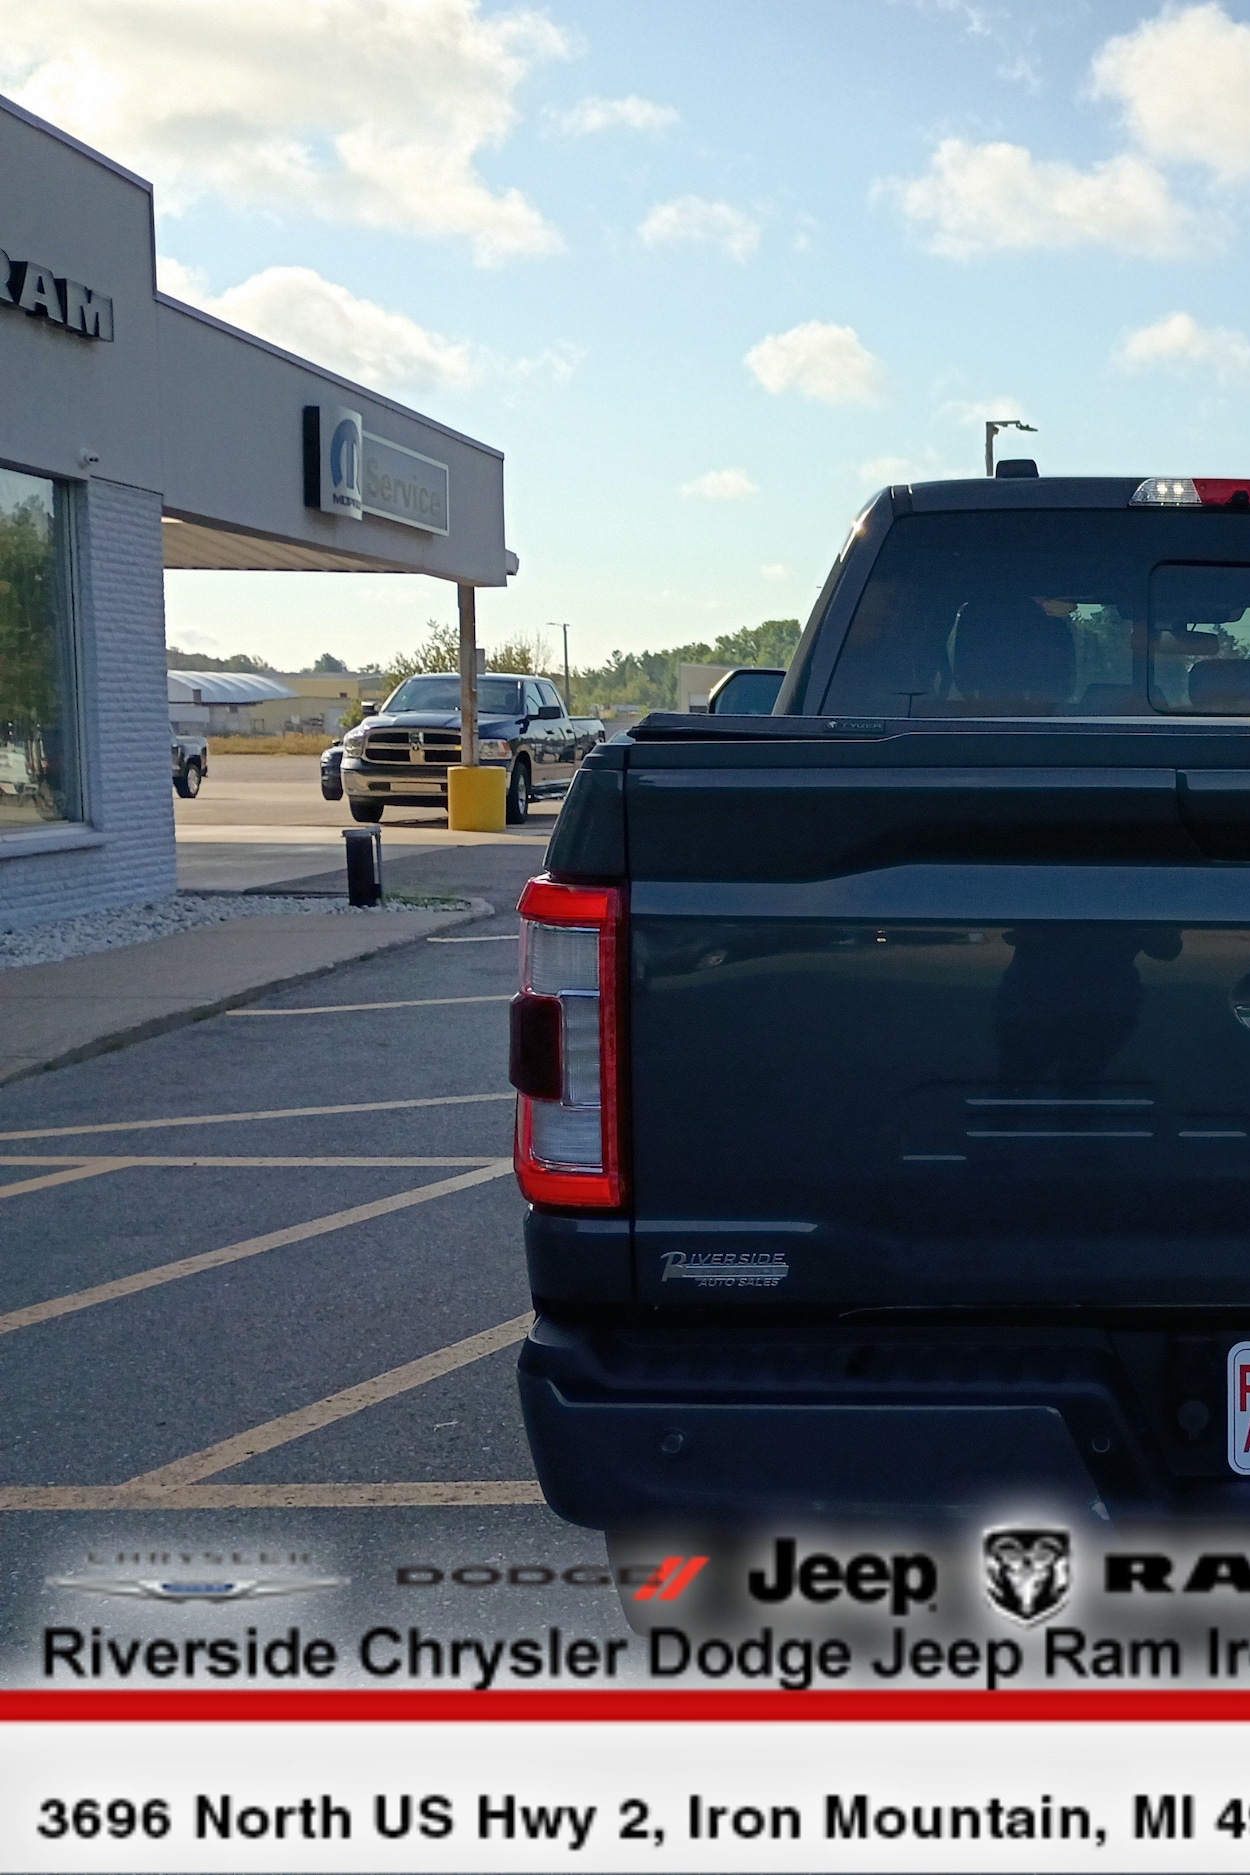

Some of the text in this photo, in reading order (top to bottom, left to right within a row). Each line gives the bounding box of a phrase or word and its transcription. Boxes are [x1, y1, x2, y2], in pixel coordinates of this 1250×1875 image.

[367, 457, 440, 515] Service
[698, 1277, 780, 1287] AUTO SALES
